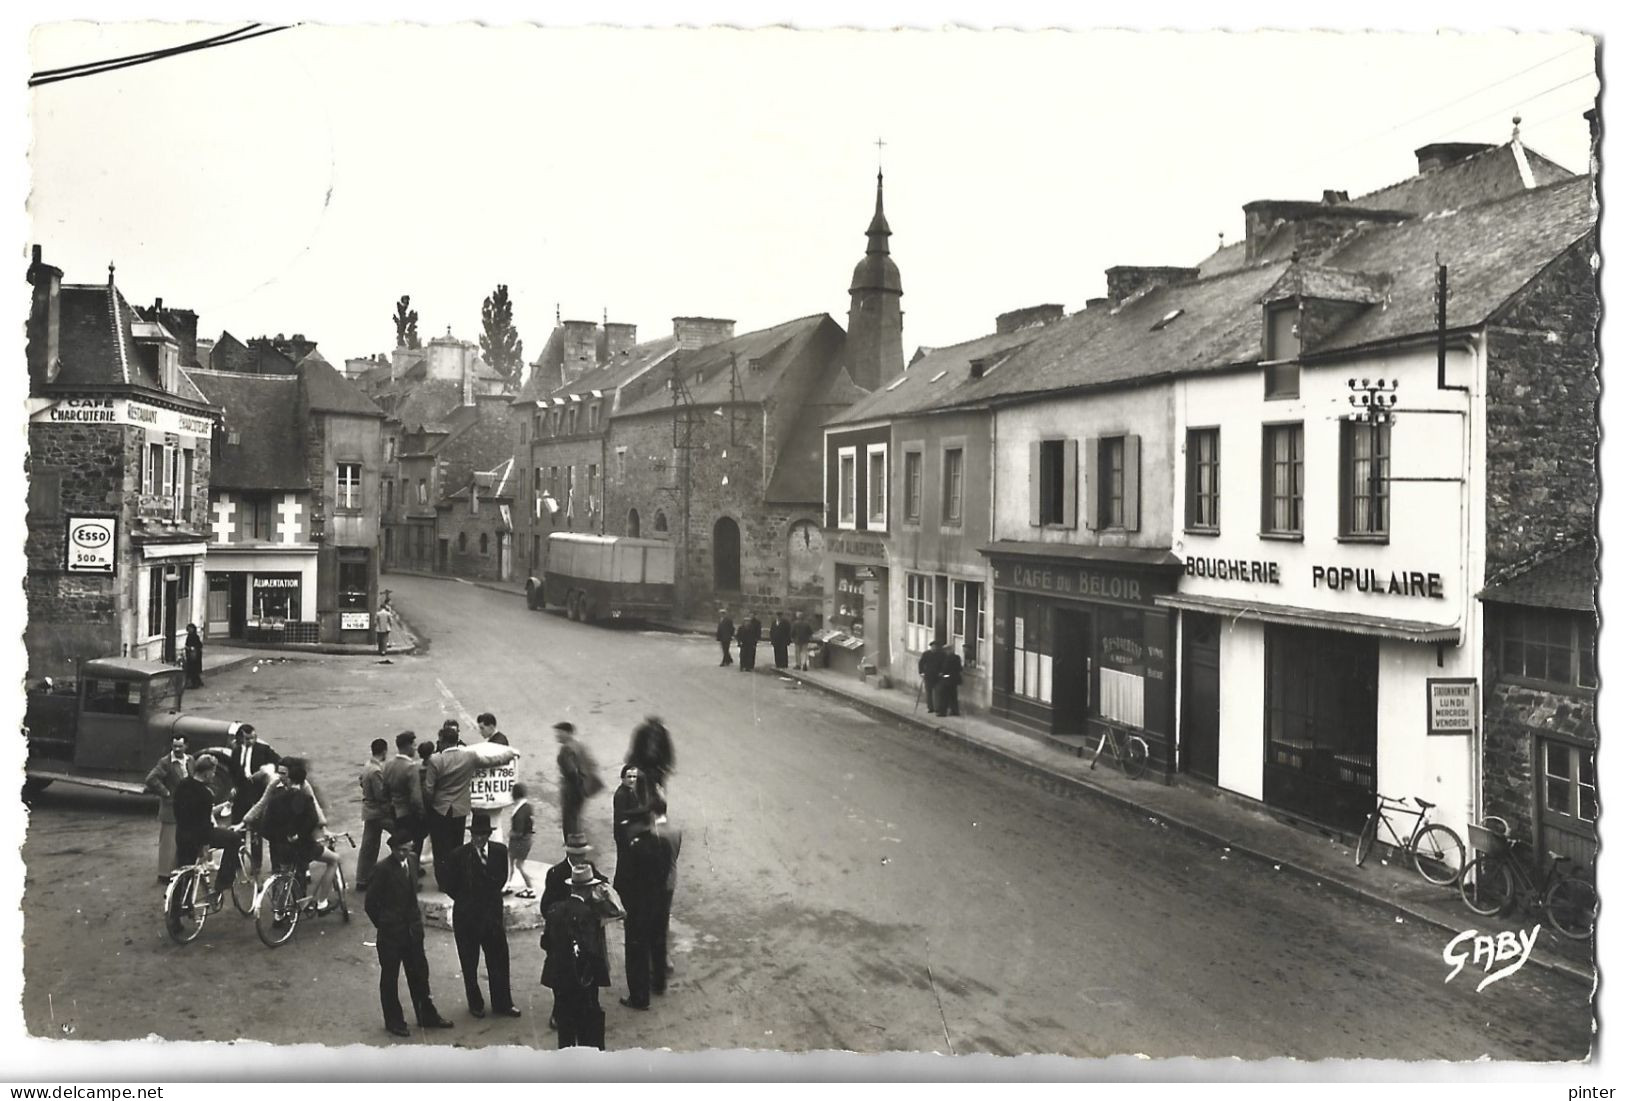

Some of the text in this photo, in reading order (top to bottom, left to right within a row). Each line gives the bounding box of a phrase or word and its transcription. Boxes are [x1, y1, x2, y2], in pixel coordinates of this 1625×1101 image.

[51, 408, 116, 422] CHARCUTERIE
[77, 529, 106, 541] Esso
[77, 553, 96, 562] 500
[1186, 555, 1444, 599] BOUCHERIE POPULAIRE
[253, 578, 298, 588] ALIMENTATION
[1056, 576, 1071, 592] DU
[1439, 698, 1465, 708] LUNDI
[1435, 709, 1469, 717] MERCREDI
[1435, 719, 1469, 728] VENDREDI
[497, 767, 514, 777] 786
[471, 779, 515, 793] LÉNEUF
[485, 793, 495, 802] 14
